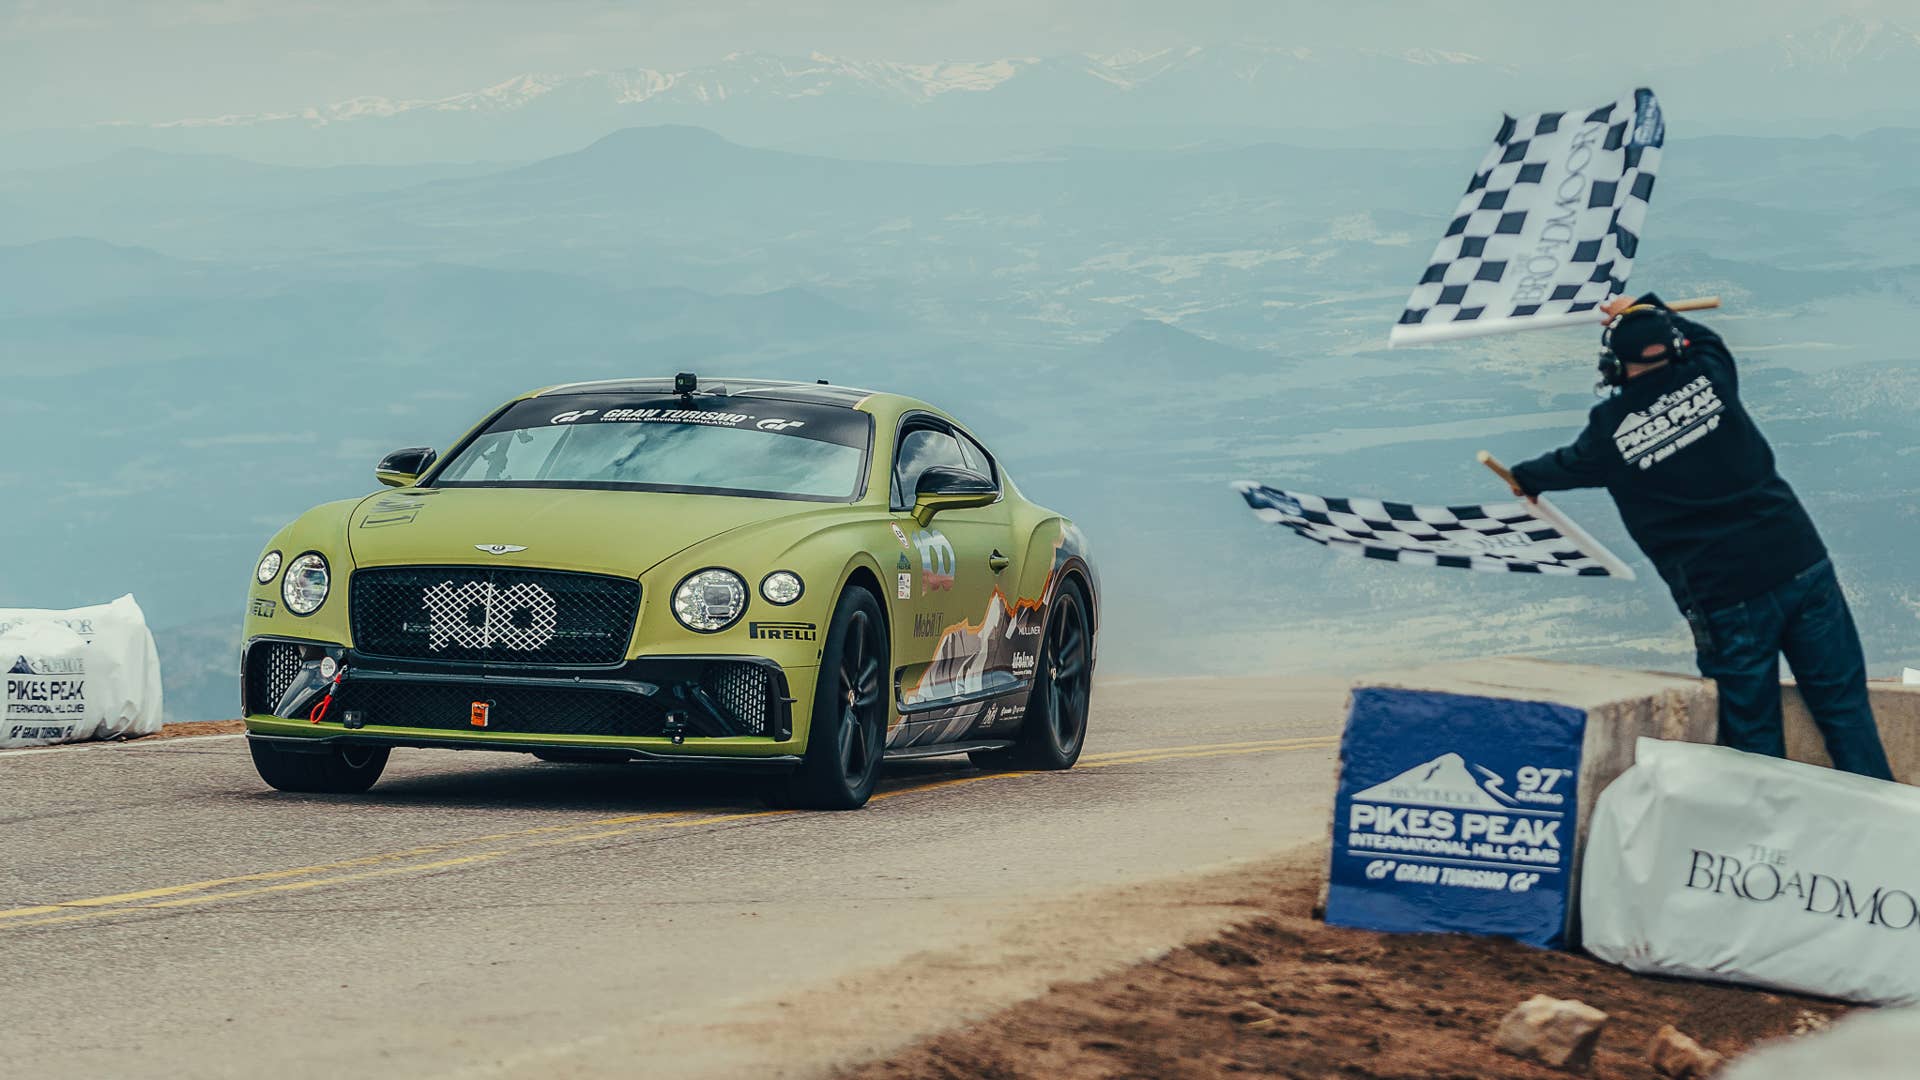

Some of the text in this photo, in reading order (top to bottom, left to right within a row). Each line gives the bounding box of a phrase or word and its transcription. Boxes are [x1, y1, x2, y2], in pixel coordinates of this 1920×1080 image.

[603, 409, 661, 418] GRAN
[663, 409, 748, 424] TURISMO
[682, 418, 737, 427] SIMULATOR
[1615, 414, 1671, 453] PIKES
[1667, 386, 1718, 425] PEAK
[422, 580, 557, 652] 100
[749, 621, 817, 641] PIRELLI
[7, 680, 85, 701] PIKES PEAK
[1350, 803, 1561, 849] PIKES PEAK
[1348, 832, 1560, 865] INTERNATIONAL HILL CLIMB
[1684, 847, 1920, 930] BROADMO
